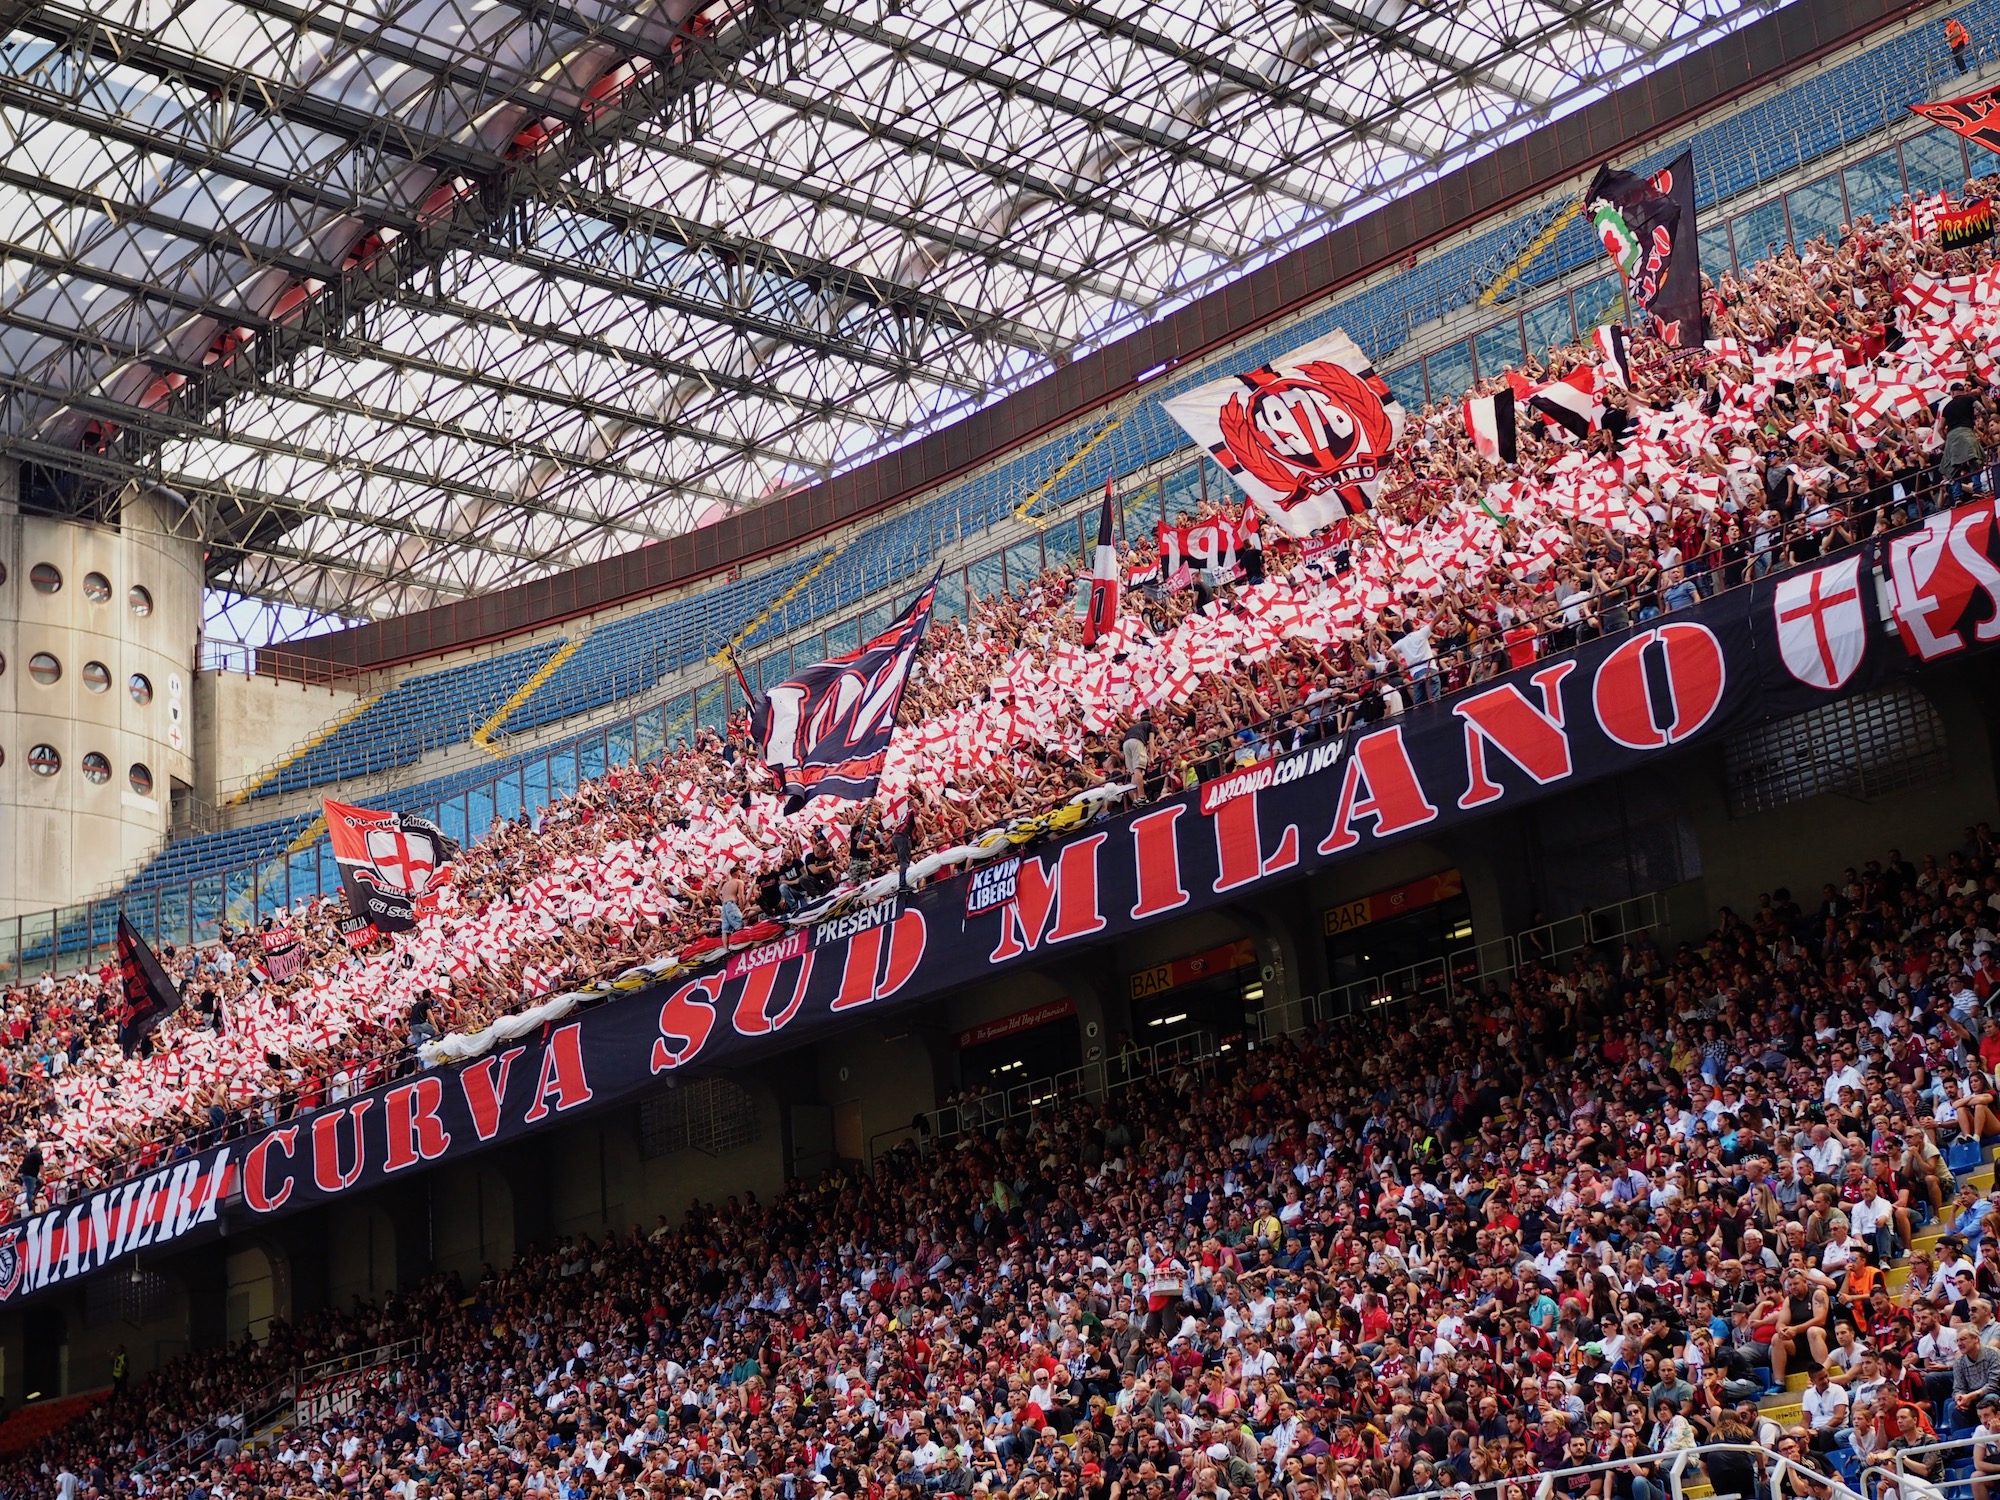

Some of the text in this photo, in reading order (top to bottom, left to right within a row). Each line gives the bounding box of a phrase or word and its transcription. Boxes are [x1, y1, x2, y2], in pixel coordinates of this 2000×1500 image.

[1255, 387, 1353, 456] 1976
[1307, 466, 1375, 493] MILANO
[1205, 766, 1272, 810] ANTONIO
[1271, 751, 1309, 787] CON
[972, 856, 1020, 891] KEVIN
[968, 876, 1016, 911] LIBERO
[243, 1021, 593, 1213] CURVA
[650, 907, 927, 1075] SUD
[990, 622, 1727, 965] MILANO
[341, 916, 368, 935] EMILIA
[815, 897, 899, 947] PRESENTI
[1326, 902, 1367, 934] BAR
[735, 933, 800, 975] ASSENTI
[1132, 967, 1170, 998] BAR
[20, 1147, 230, 1296] MANIERA
